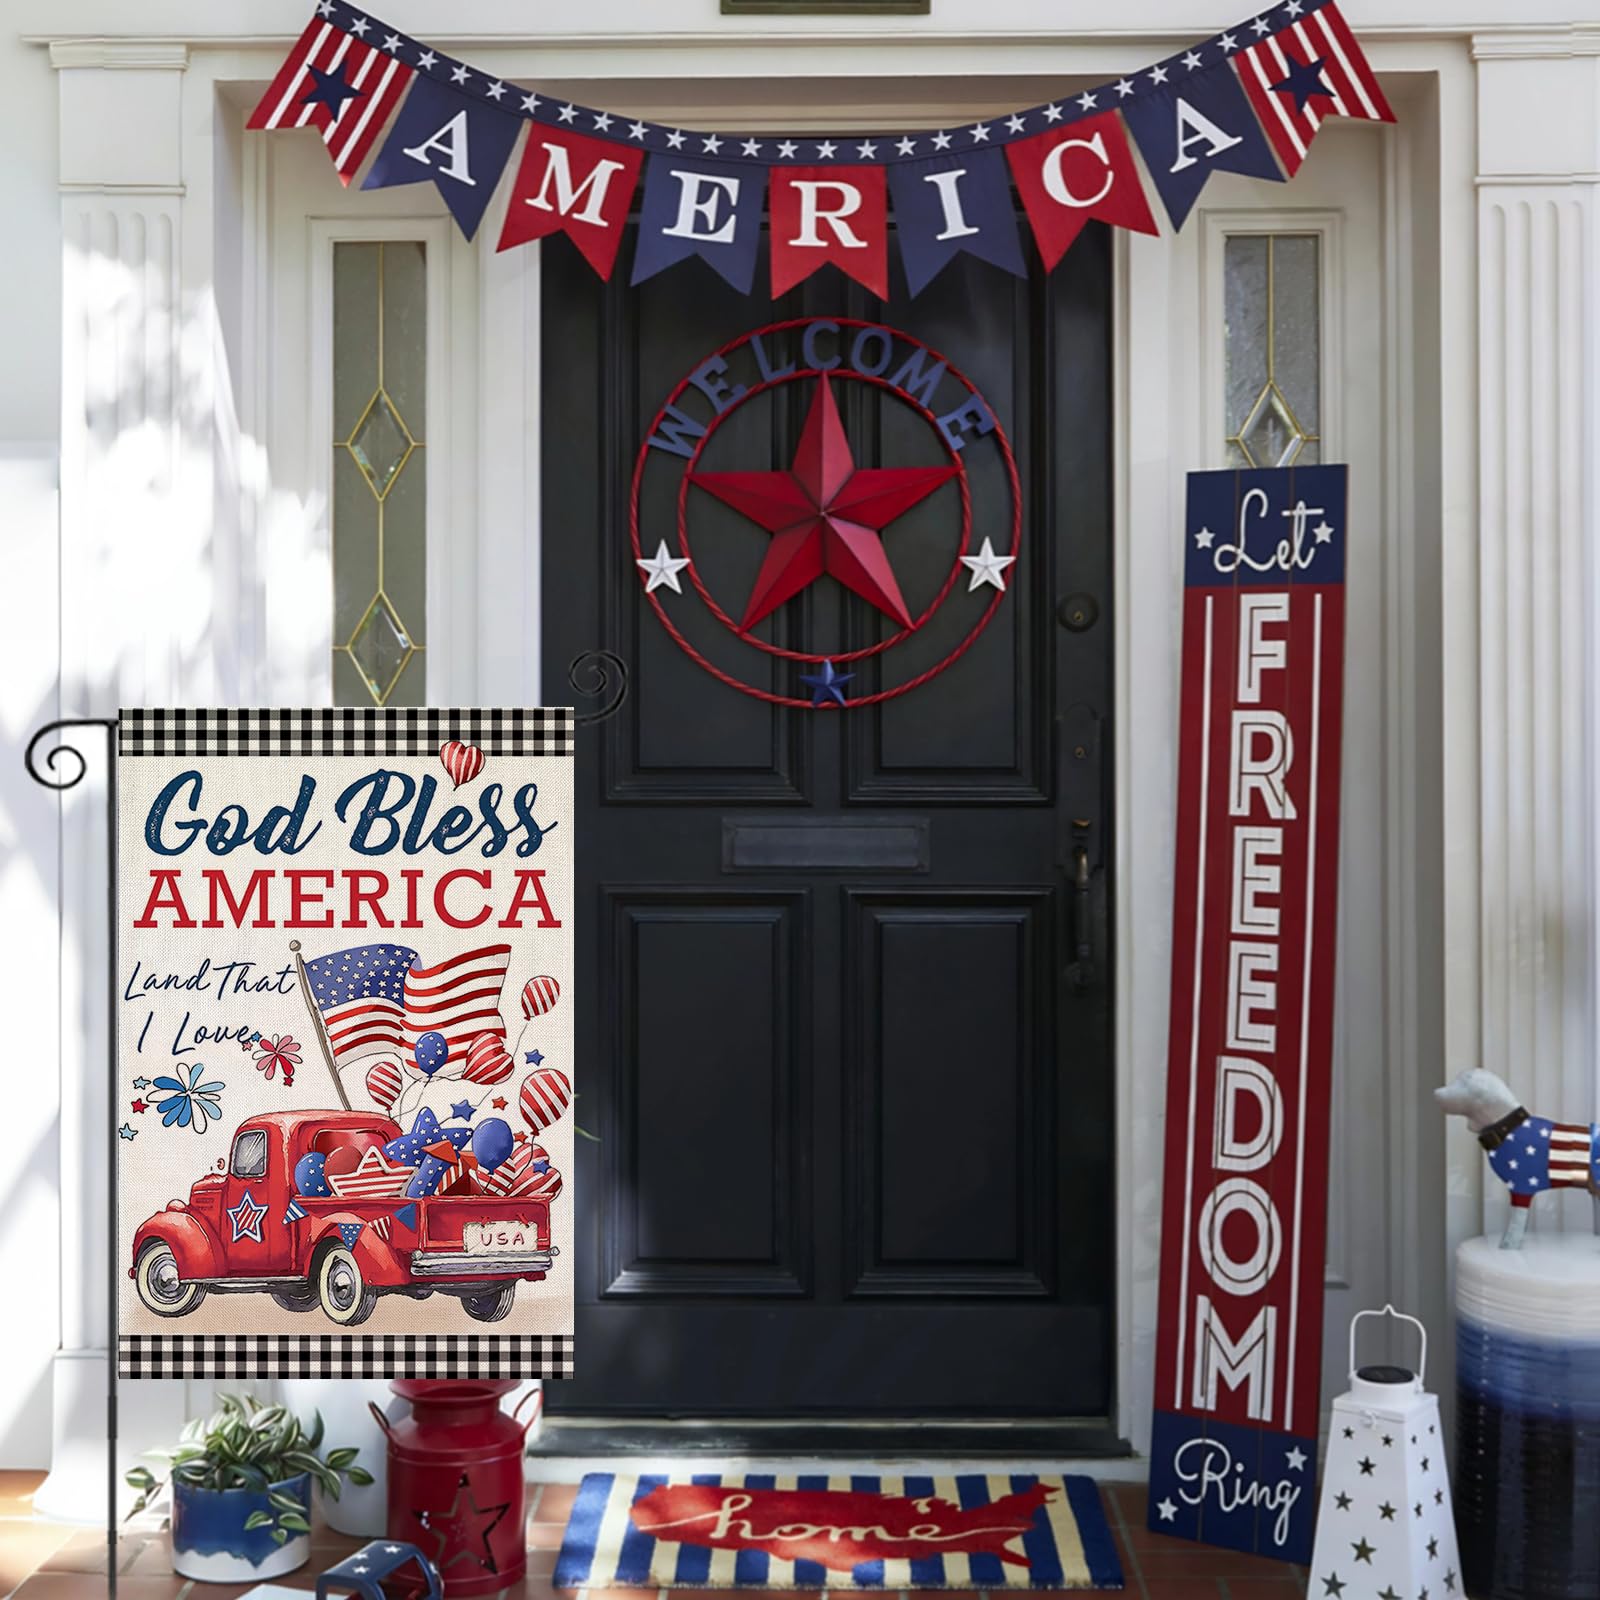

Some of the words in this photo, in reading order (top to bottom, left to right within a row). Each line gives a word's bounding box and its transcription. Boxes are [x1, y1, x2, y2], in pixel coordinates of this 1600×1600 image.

[403, 97, 1243, 248] AMERICA
[648, 320, 995, 459] WELCOME
[1214, 488, 1324, 573] Let
[144, 770, 322, 855] God
[335, 769, 558, 858] Bless
[133, 869, 562, 929] AMERICA
[124, 958, 213, 1001] Land
[212, 962, 297, 1000] That
[1192, 593, 1297, 1423] FREEDOM
[137, 1011, 154, 1053] I
[172, 1011, 253, 1055] Love
[480, 1231, 525, 1246] USA
[637, 1494, 1037, 1542] home
[1175, 1438, 1301, 1546] Ring
